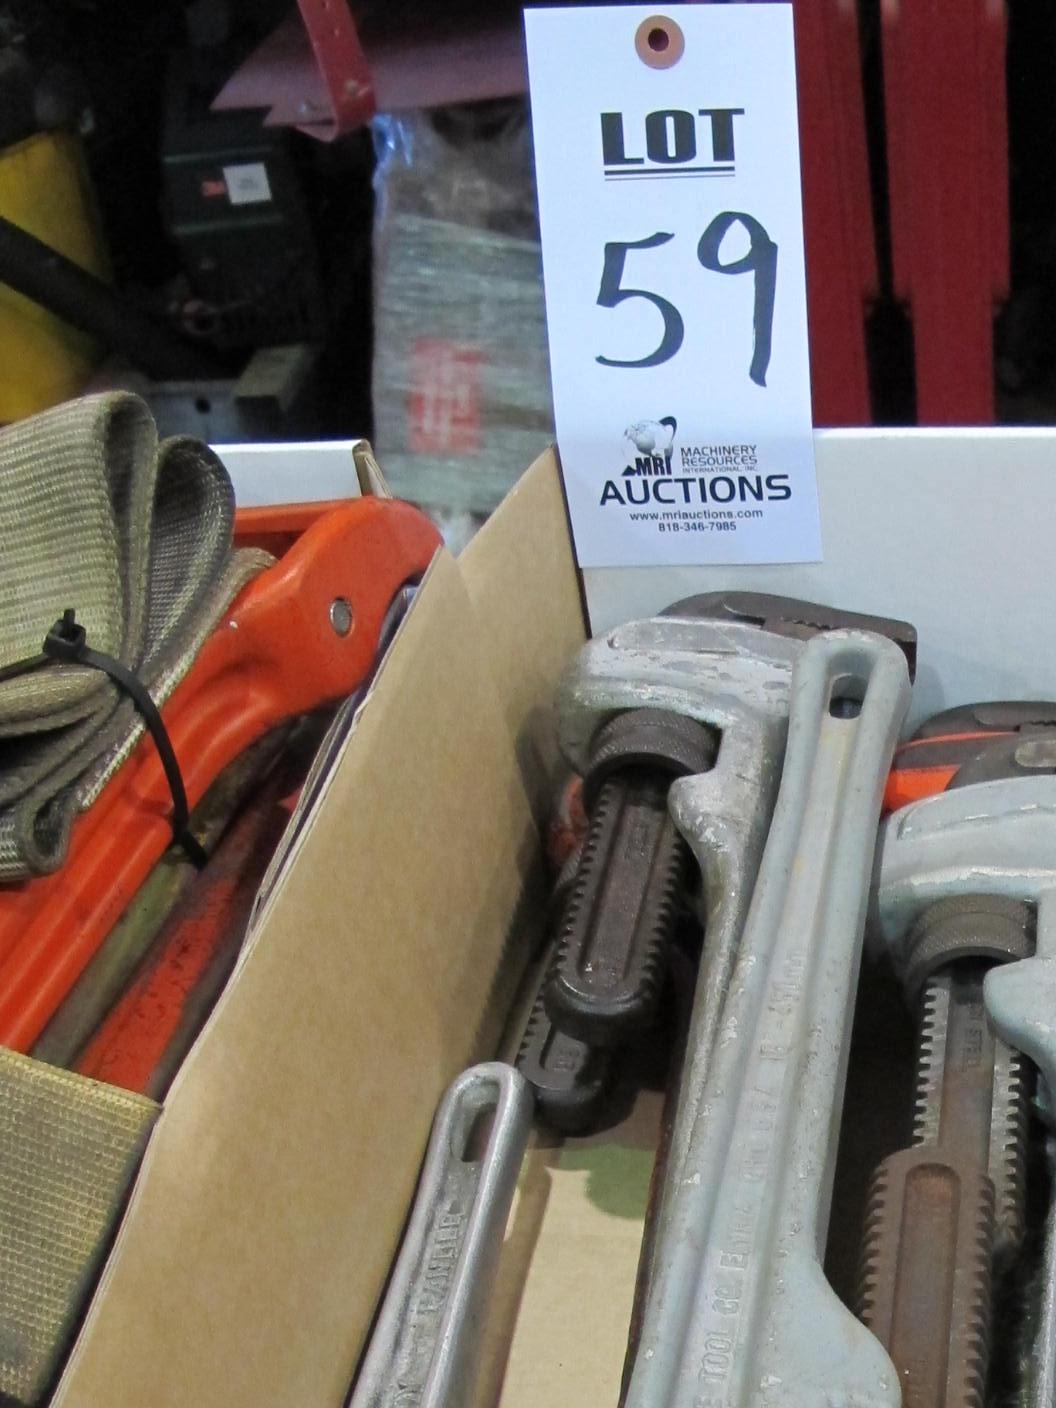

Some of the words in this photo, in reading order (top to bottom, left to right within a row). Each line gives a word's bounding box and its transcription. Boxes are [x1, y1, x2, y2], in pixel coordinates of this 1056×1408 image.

[600, 108, 745, 165] LOT
[595, 211, 778, 387] 59
[680, 444, 758, 457] MACHINERY
[635, 455, 672, 476] MRI
[682, 455, 758, 467] RESOURCES
[600, 474, 791, 507] AUCTIONS
[629, 508, 763, 521] www.mriauctions.com
[658, 521, 737, 532] 818-346-7985
